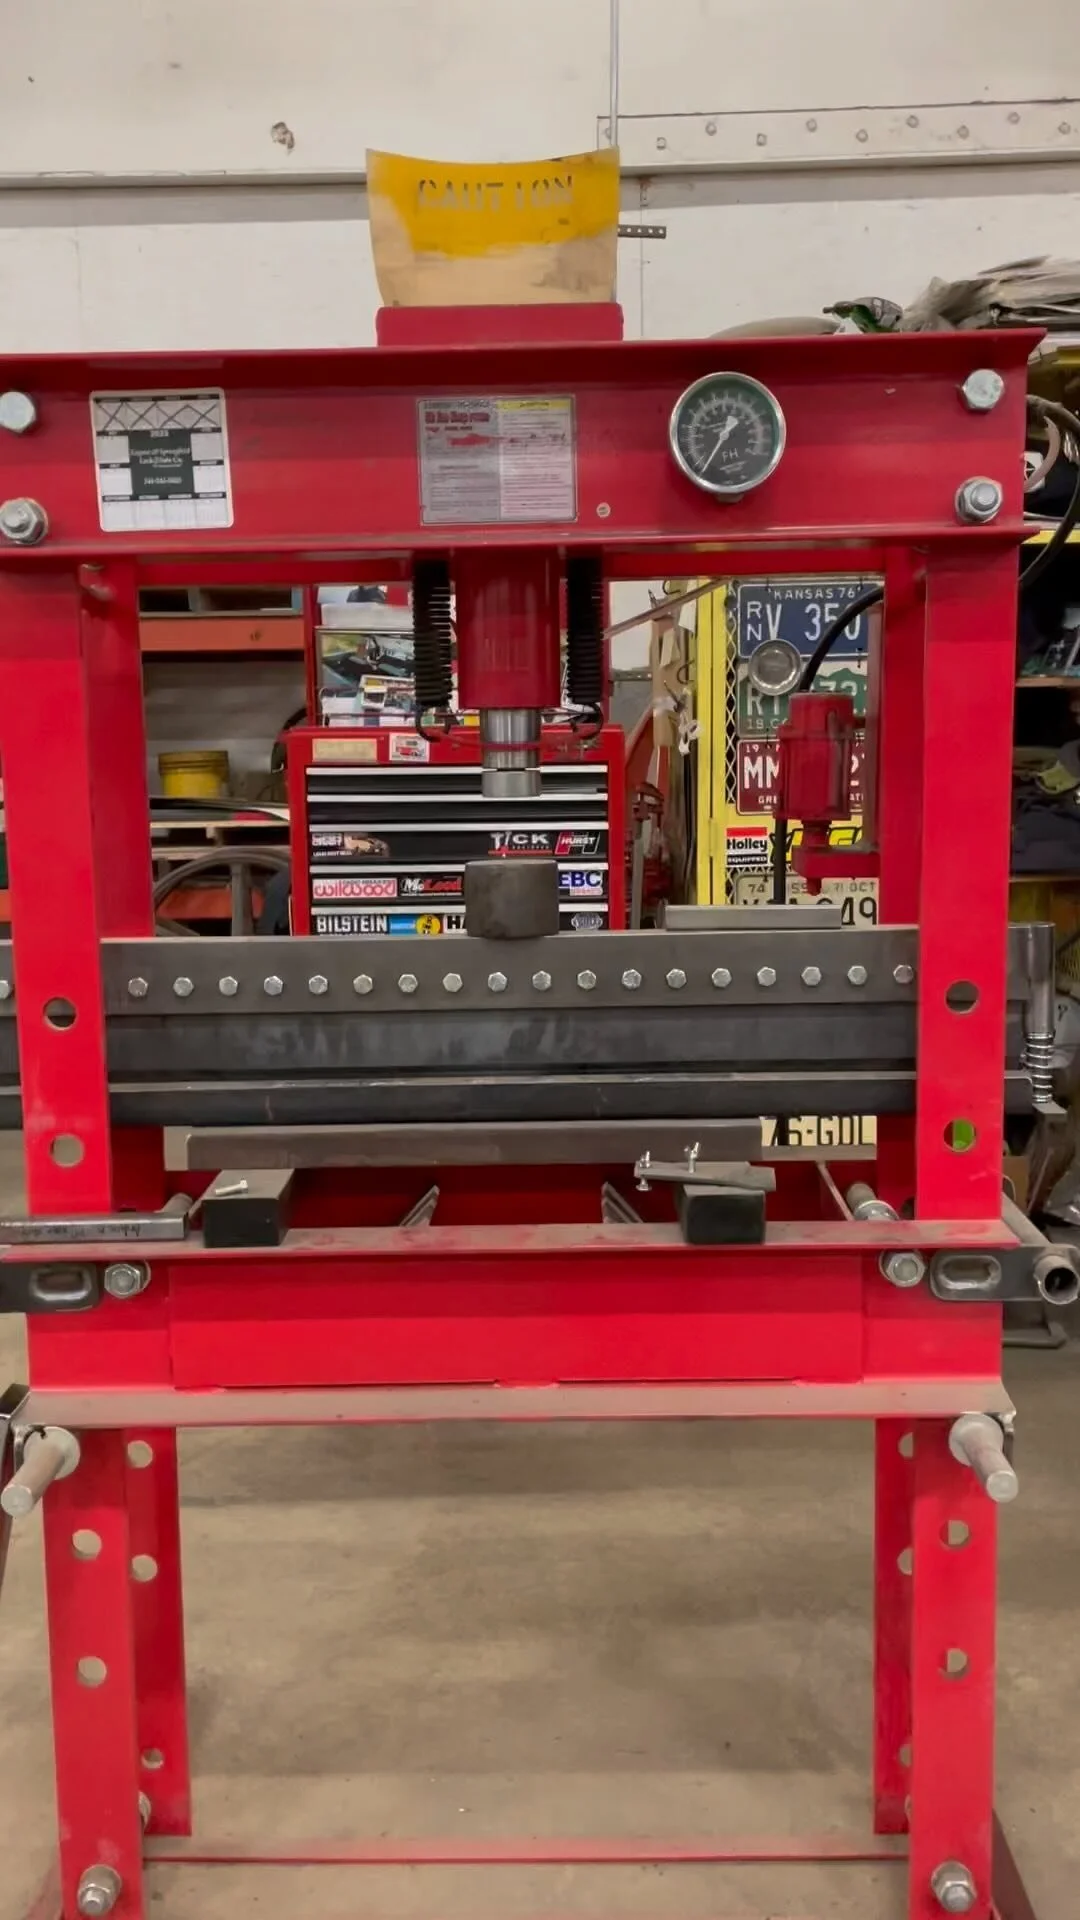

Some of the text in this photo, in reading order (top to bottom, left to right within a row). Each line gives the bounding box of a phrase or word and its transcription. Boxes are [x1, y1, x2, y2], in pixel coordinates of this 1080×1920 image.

[417, 175, 574, 213] CAUTION
[774, 587, 856, 600] KANSAS 76
[747, 601, 762, 620] R
[747, 623, 762, 641] N
[560, 836, 596, 845] HURST
[727, 838, 767, 854] Holley
[559, 871, 602, 888] EBC
[850, 882, 875, 893] OCT
[750, 884, 765, 894] 74
[316, 915, 388, 933] BILSTEIN
